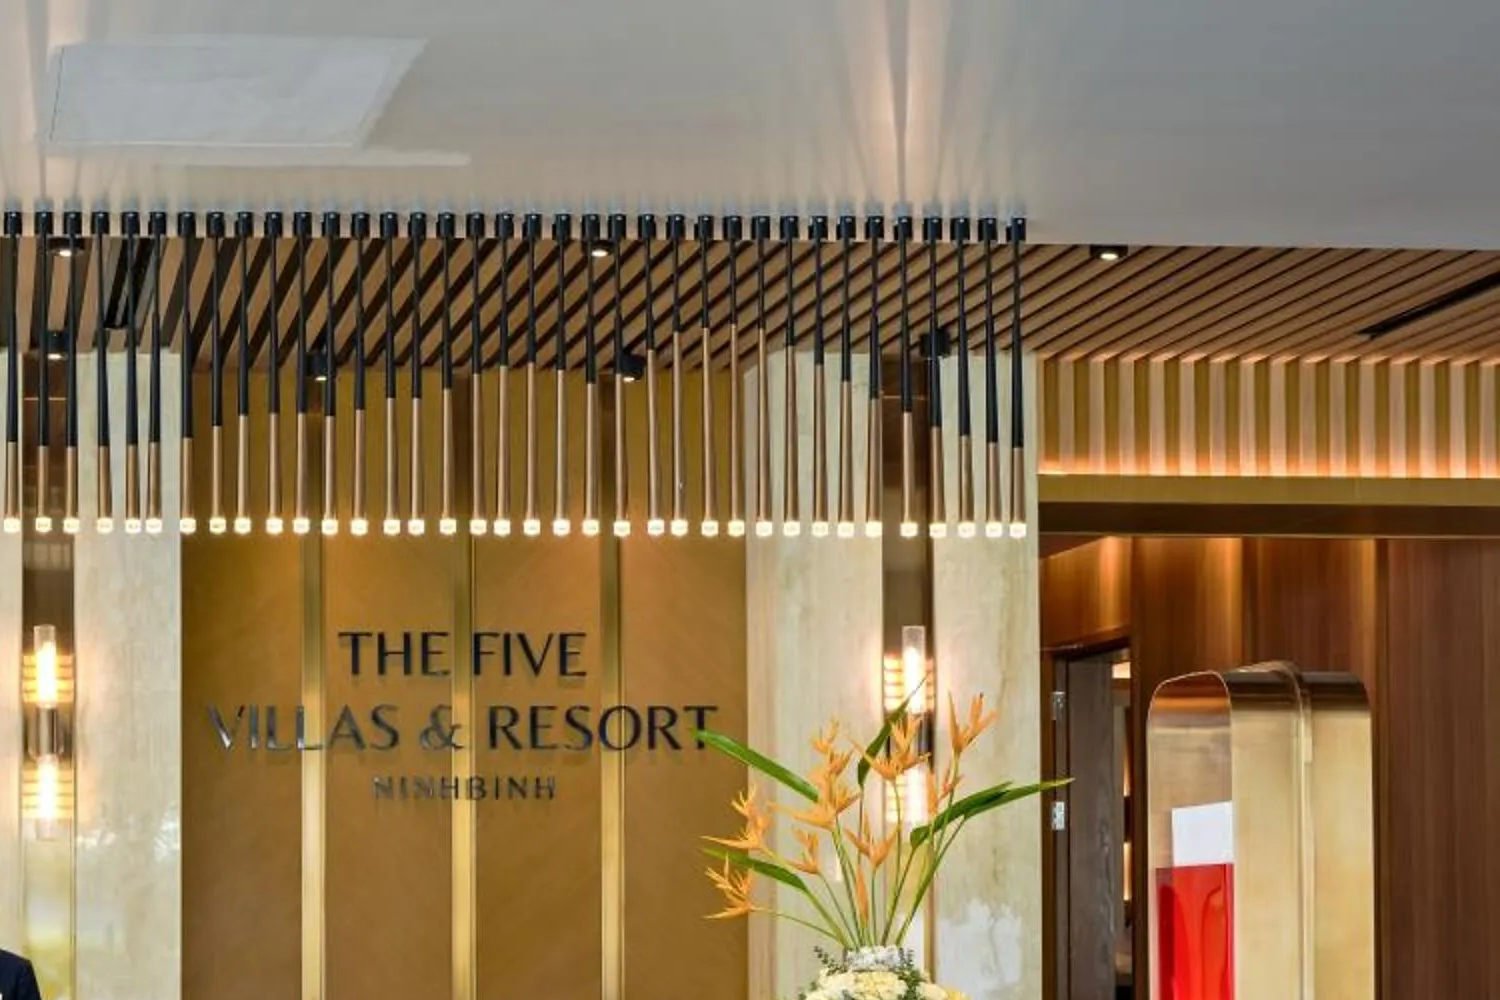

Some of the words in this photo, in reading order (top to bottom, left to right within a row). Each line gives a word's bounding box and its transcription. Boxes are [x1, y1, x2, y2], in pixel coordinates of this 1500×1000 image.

[338, 631, 451, 676] THE
[473, 631, 588, 677] FIVE
[207, 704, 400, 751] VILLAS
[419, 704, 465, 751] &
[487, 704, 719, 751] RESORT
